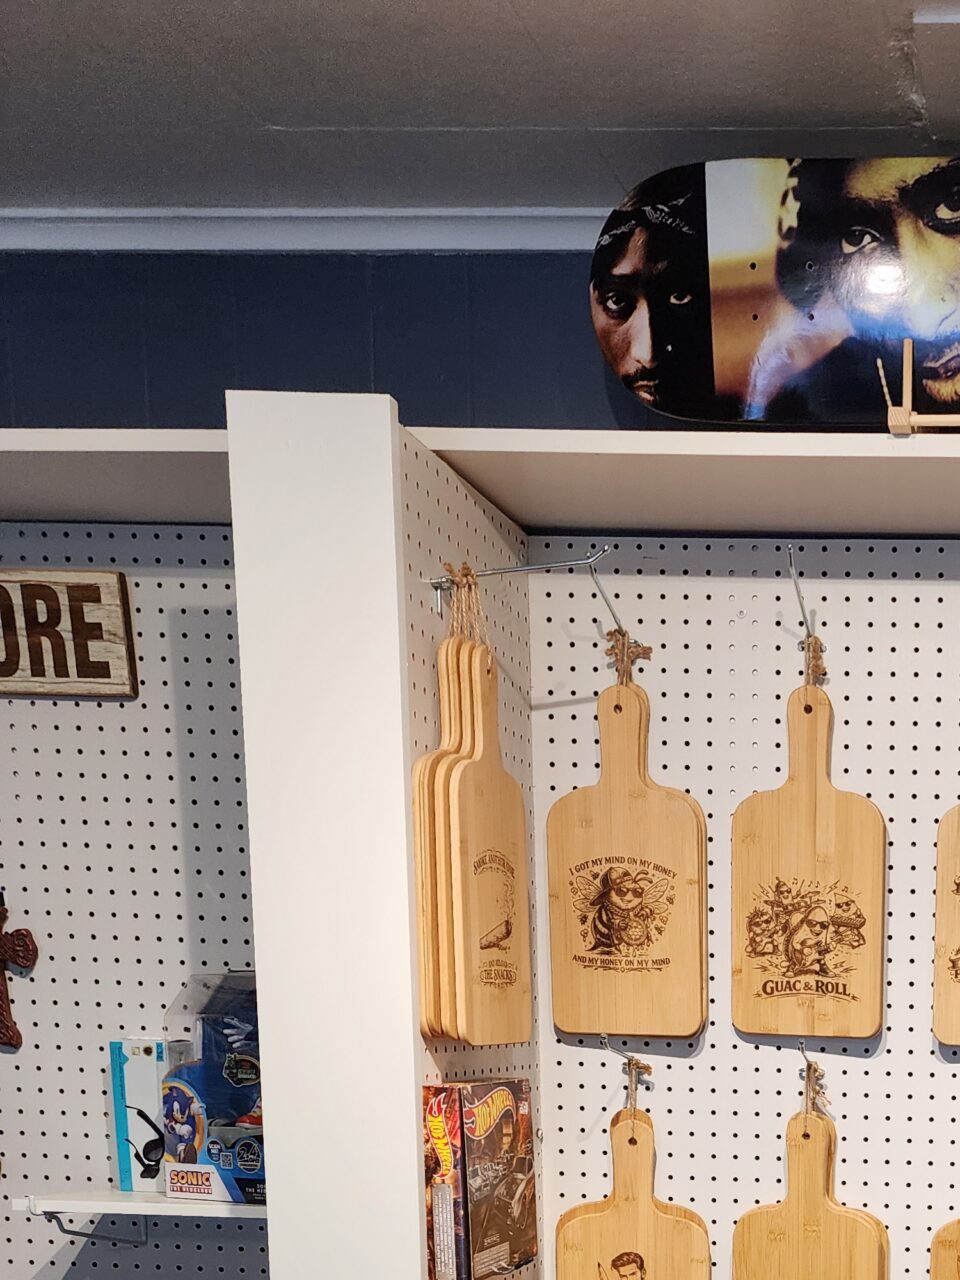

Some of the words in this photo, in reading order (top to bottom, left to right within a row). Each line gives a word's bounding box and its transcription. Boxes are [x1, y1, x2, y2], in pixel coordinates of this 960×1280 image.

[569, 868, 574, 876] I
[575, 861, 590, 874] GOT
[592, 858, 604, 867] MY
[605, 856, 626, 864] MIND
[627, 857, 638, 865] ON
[640, 859, 652, 869] MY
[653, 863, 678, 880] HONEY
[572, 955, 587, 964] AND
[588, 957, 600, 965] MY
[652, 958, 671, 966] MIND
[762, 980, 801, 996] GUAC
[803, 981, 814, 991] &
[815, 980, 851, 997] ROLL
[170, 1170, 212, 1186] SONIC
